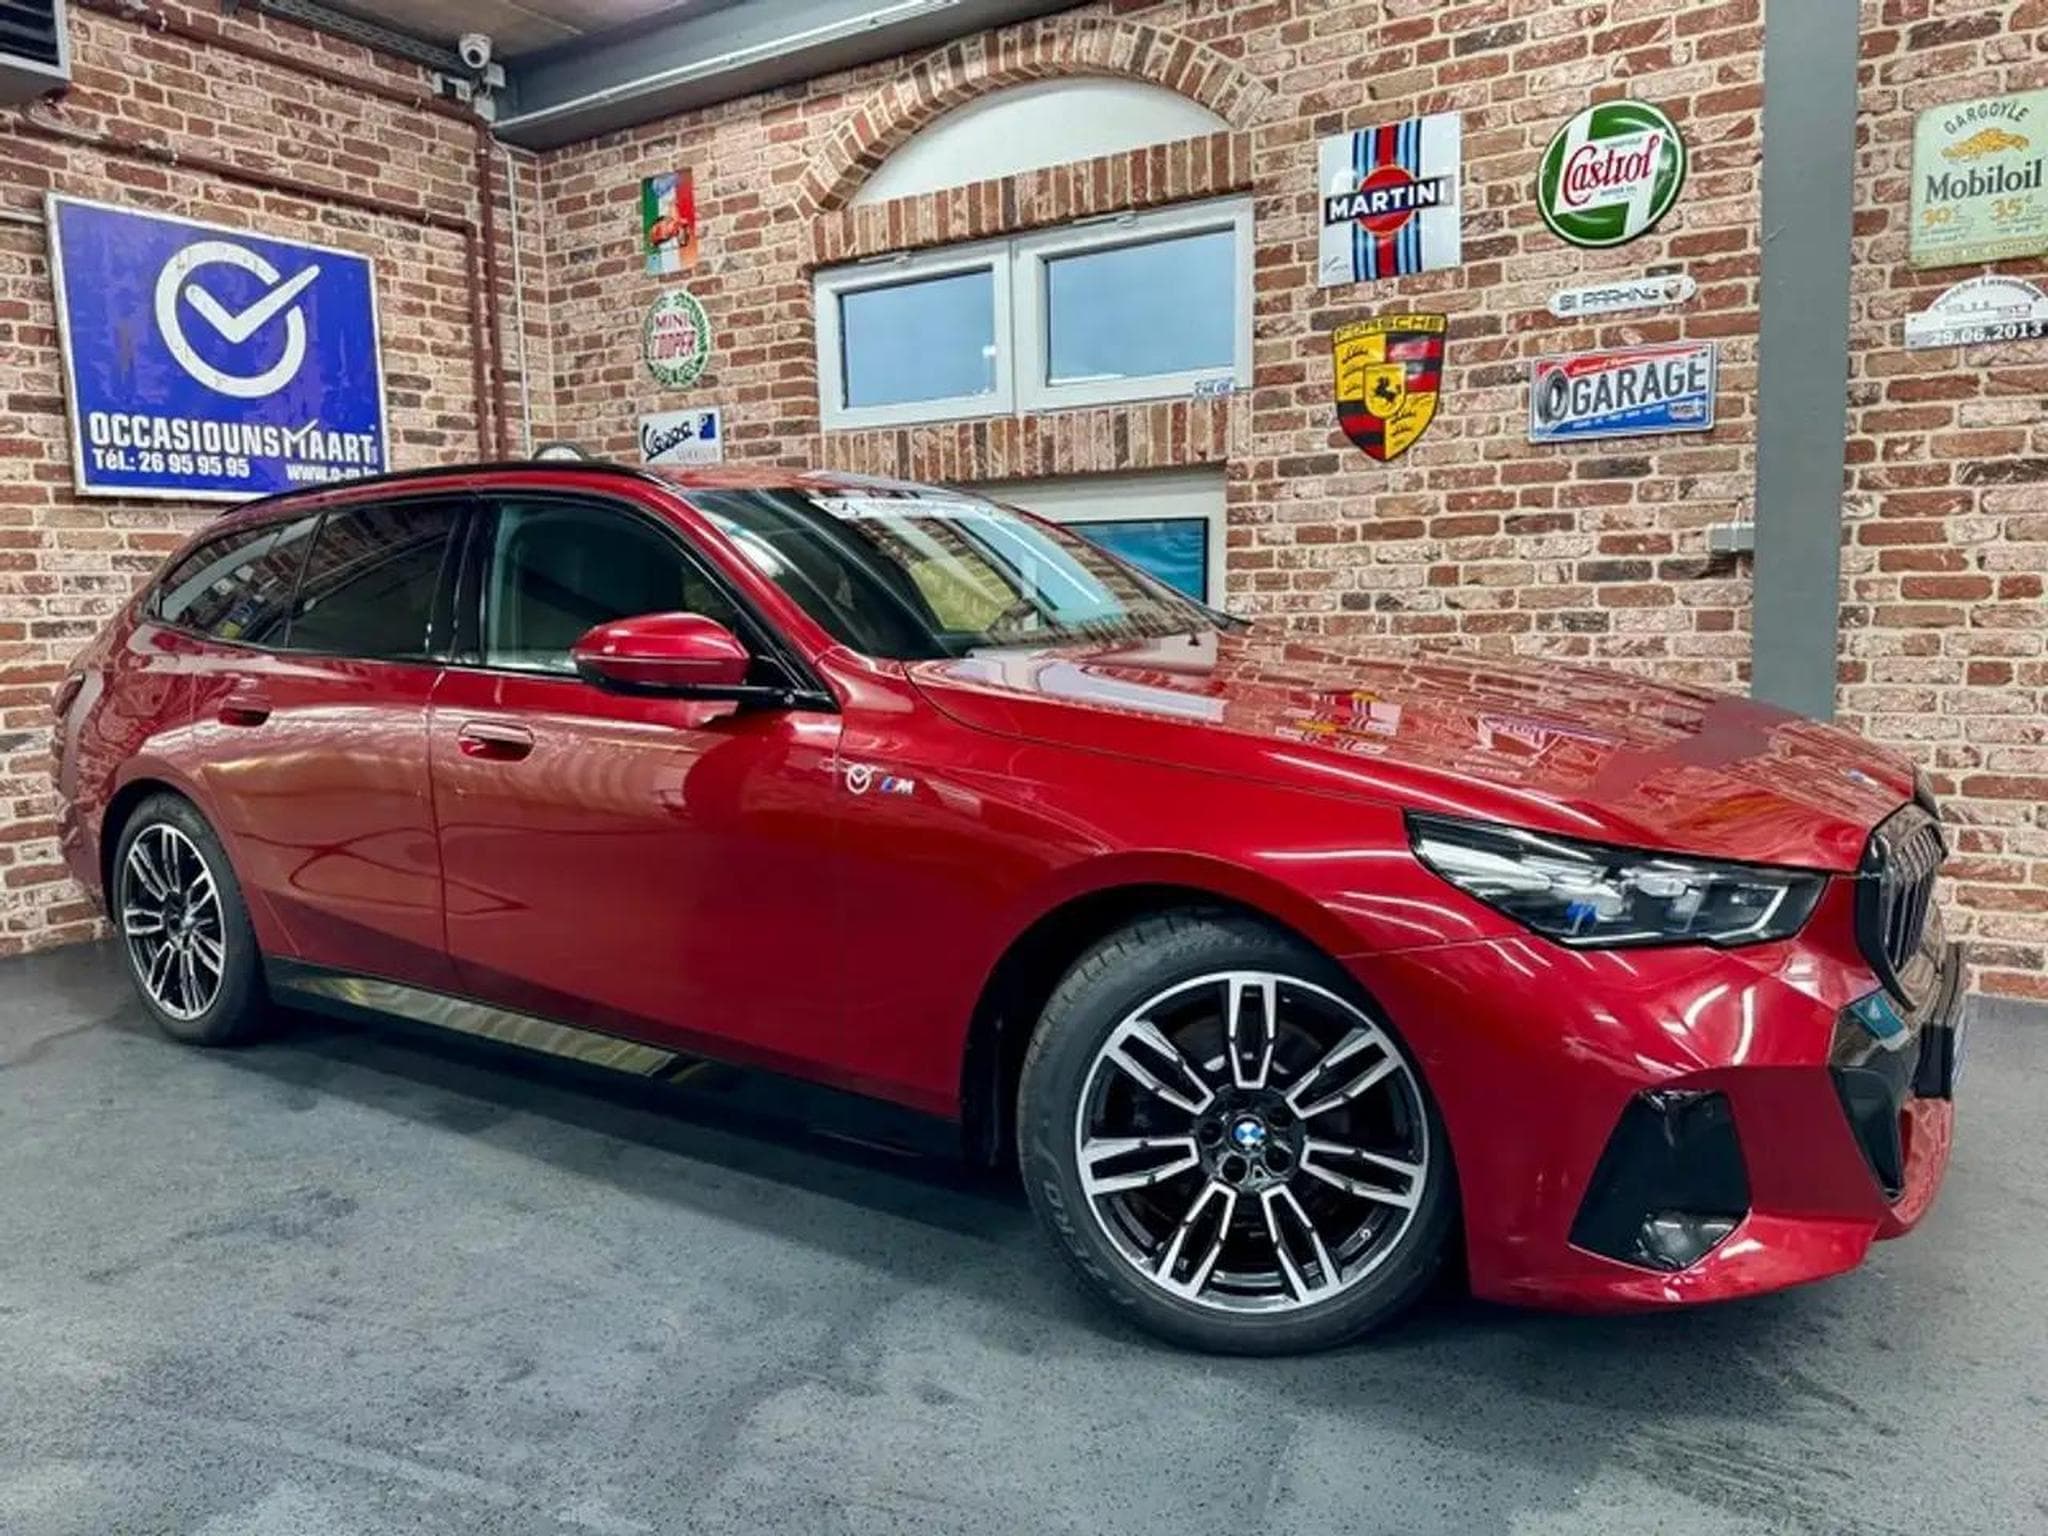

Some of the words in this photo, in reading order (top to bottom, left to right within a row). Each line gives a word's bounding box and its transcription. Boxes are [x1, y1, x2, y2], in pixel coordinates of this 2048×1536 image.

[1944, 102, 2030, 135] GARGOYLE
[1562, 134, 1660, 206] Castrol
[1925, 158, 2043, 203] Mobiloil
[1330, 180, 1445, 220] MARTINI
[1583, 287, 1660, 306] PARKING
[654, 312, 690, 330] MINI
[1571, 360, 1707, 417] GARAGE
[138, 453, 164, 474] 26
[168, 455, 193, 476] 95
[197, 457, 222, 477] 95
[226, 459, 250, 479] 95
[286, 464, 378, 483] www.o-m
